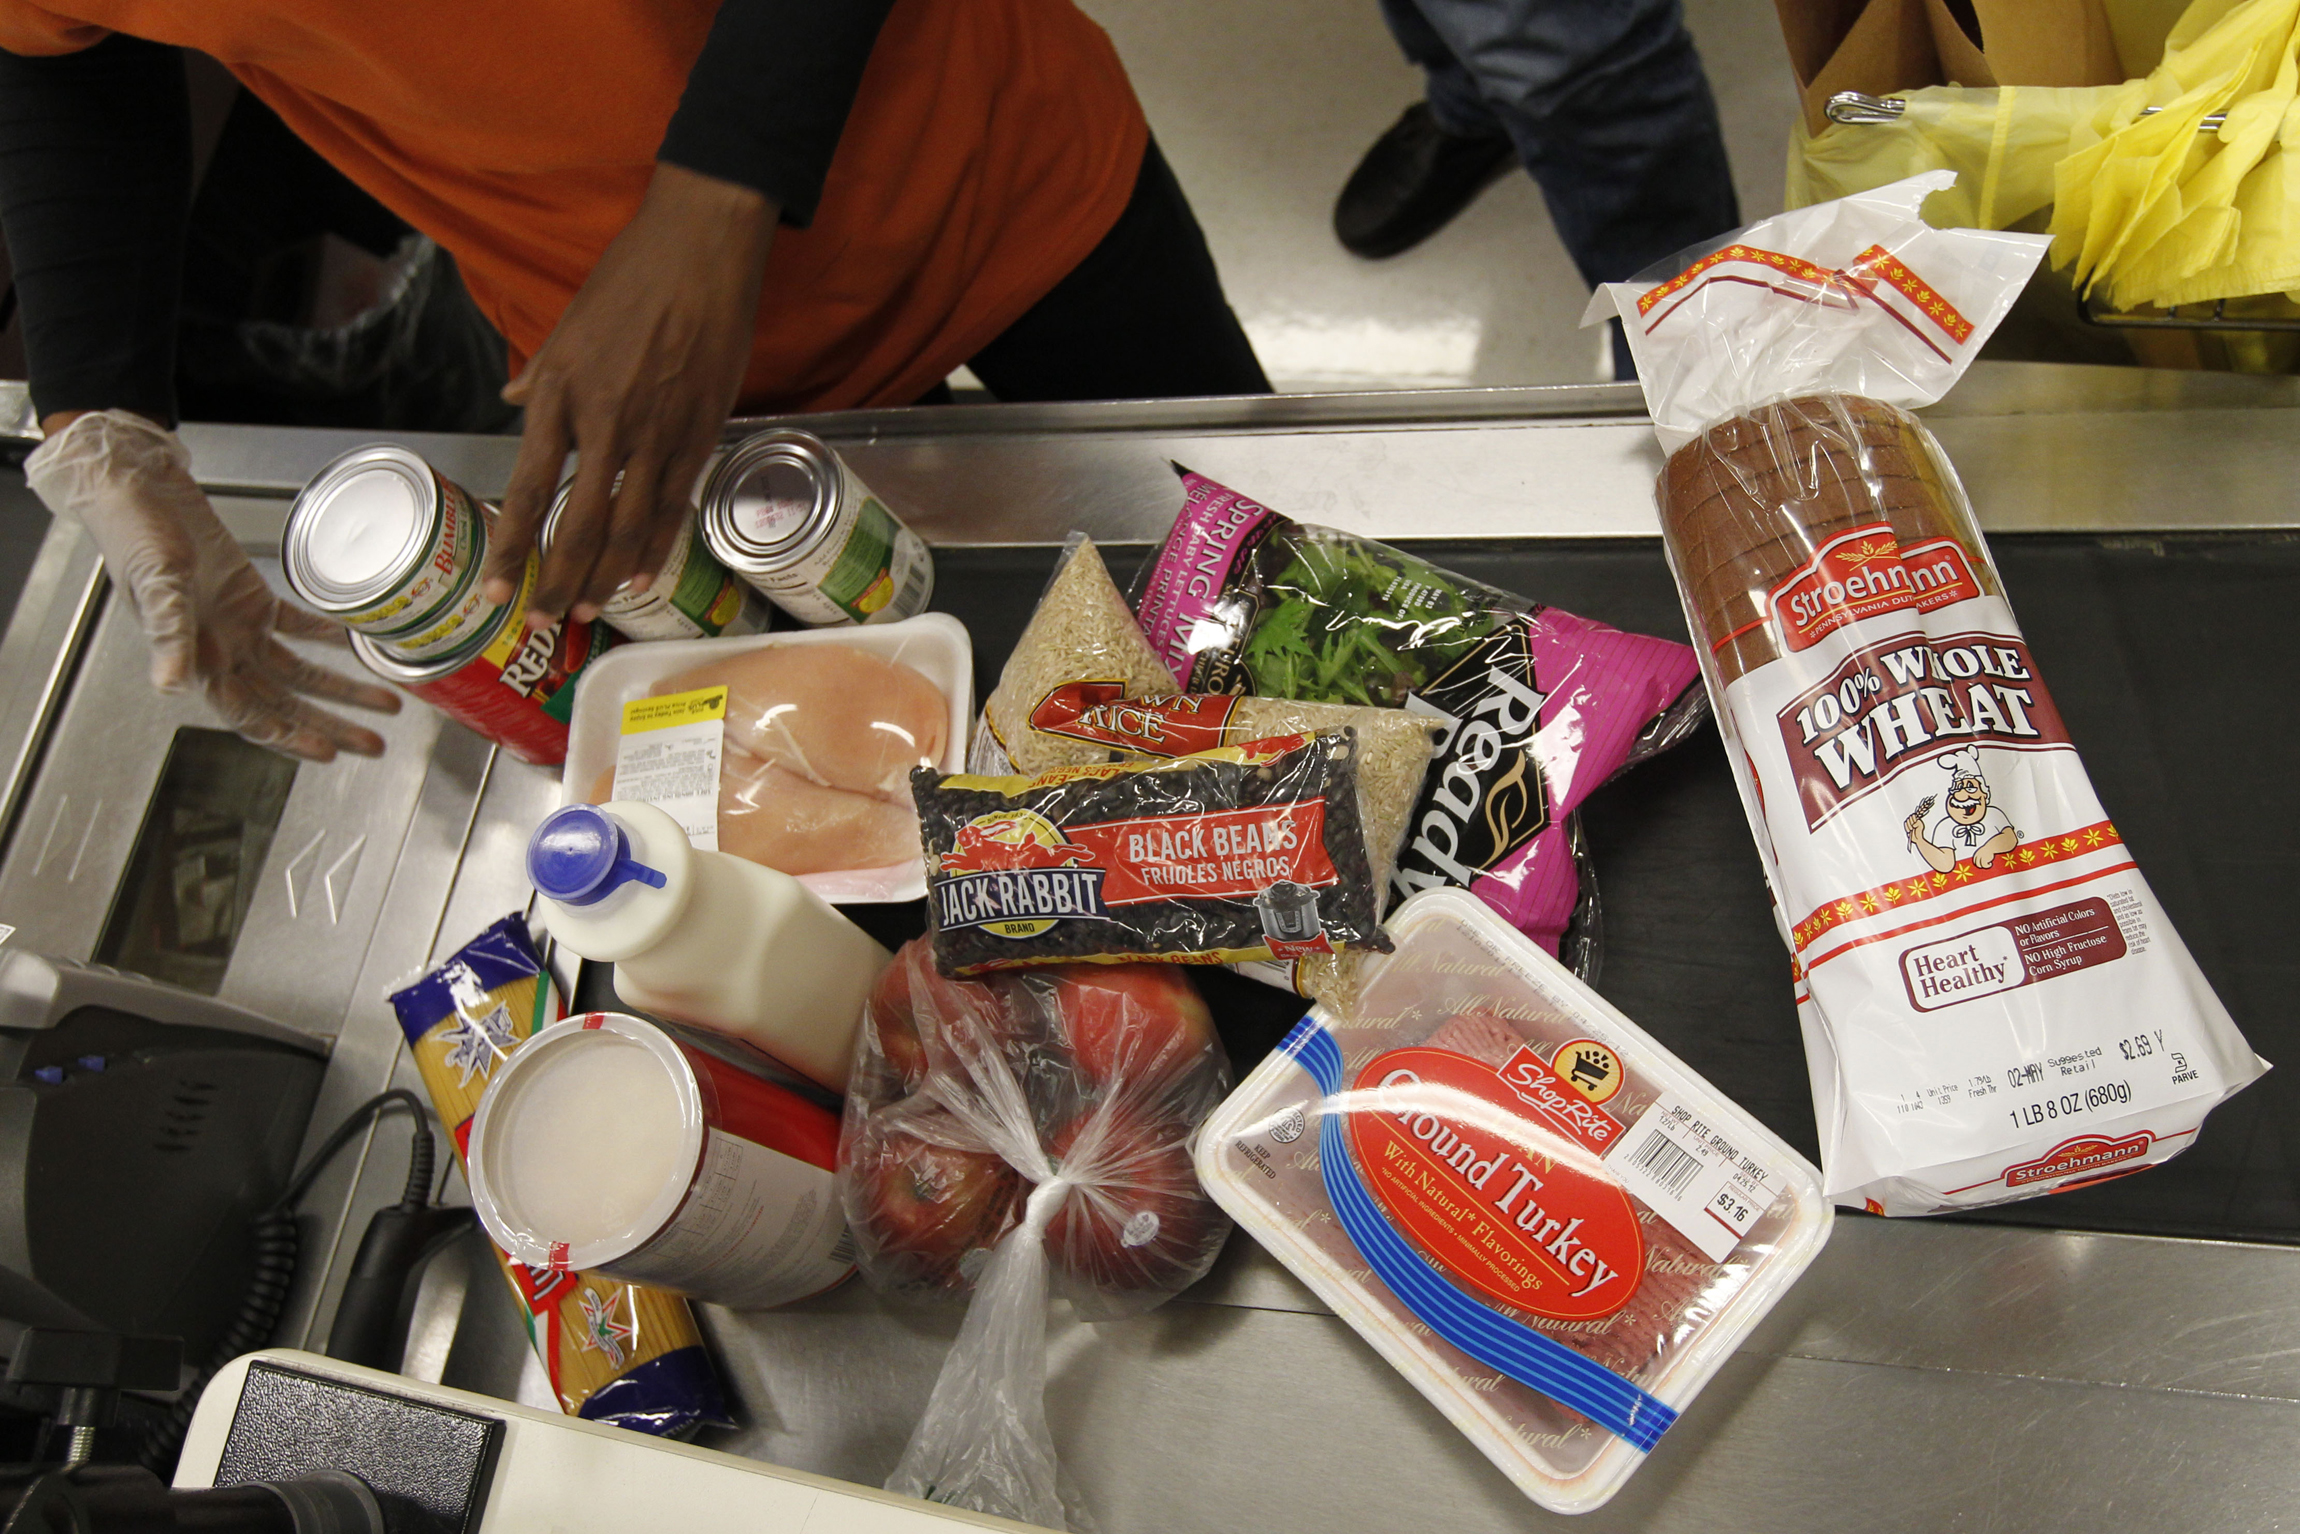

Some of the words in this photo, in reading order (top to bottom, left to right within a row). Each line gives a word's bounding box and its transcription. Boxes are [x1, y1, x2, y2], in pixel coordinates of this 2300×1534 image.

[1202, 492, 1234, 523] FRESH
[1187, 498, 1264, 600] SPRING
[1142, 568, 1171, 637] PRINTA
[1157, 570, 1188, 648] LETTUCES
[1915, 592, 1949, 609] AKERS
[1796, 667, 1881, 745] 100%
[1812, 682, 2041, 791] WHEAT
[1128, 825, 1208, 863] BLACK
[1212, 819, 1298, 856] BEANS
[1141, 863, 1218, 886] FRIJOLES
[1221, 855, 1290, 881] NEGROS
[940, 877, 996, 927] JACK
[997, 872, 1097, 916] RABBIT
[1004, 922, 1035, 934] BRAND
[2015, 923, 2031, 936] NO
[2032, 914, 2068, 933] Artificial
[2068, 907, 2096, 922] Colors
[2019, 937, 2030, 947] or
[2030, 928, 2060, 945] Flavors
[1913, 943, 1980, 978] Heart
[2024, 952, 2041, 965] NO
[2042, 945, 2068, 962] High
[2068, 934, 2108, 953] Fructose
[2029, 962, 2053, 976] Corn
[2054, 954, 2083, 972] Syrup
[2047, 1046, 2103, 1068] Suggested
[2118, 1034, 2153, 1061] $2.69
[2154, 1030, 2165, 1051] Y
[2060, 1060, 2096, 1076] Retail
[2171, 1069, 2199, 1085] PARVE
[1506, 1062, 1612, 1142] ShopRite
[2009, 1109, 2020, 1129] 1
[2022, 1104, 2045, 1126] LB
[2049, 1101, 2058, 1119] 8
[2060, 1092, 2083, 1116] OZ
[2084, 1079, 2132, 1113] (680g)
[1235, 1140, 1277, 1181] REFRIGERATED
[1253, 1143, 1272, 1160] KEEP
[1671, 1105, 1692, 1122] SHOP
[1690, 1119, 1711, 1138] RITE
[1710, 1135, 1740, 1160] GROUND
[1739, 1156, 1769, 1182] TURKEY
[2015, 1145, 2140, 1181] Stroehmann
[1384, 1140, 1417, 1178] With
[1472, 1221, 1543, 1291] Flavorings
[1716, 1193, 1749, 1222] $3.16
[1391, 1176, 1422, 1204] ARTIFICIAL
[1421, 1201, 1454, 1235] INGREDIENTS
[1457, 1234, 1488, 1263] MINIMALLY
[1485, 1260, 1520, 1293] PROCESSED
[1494, 1161, 1619, 1298] Turkey
